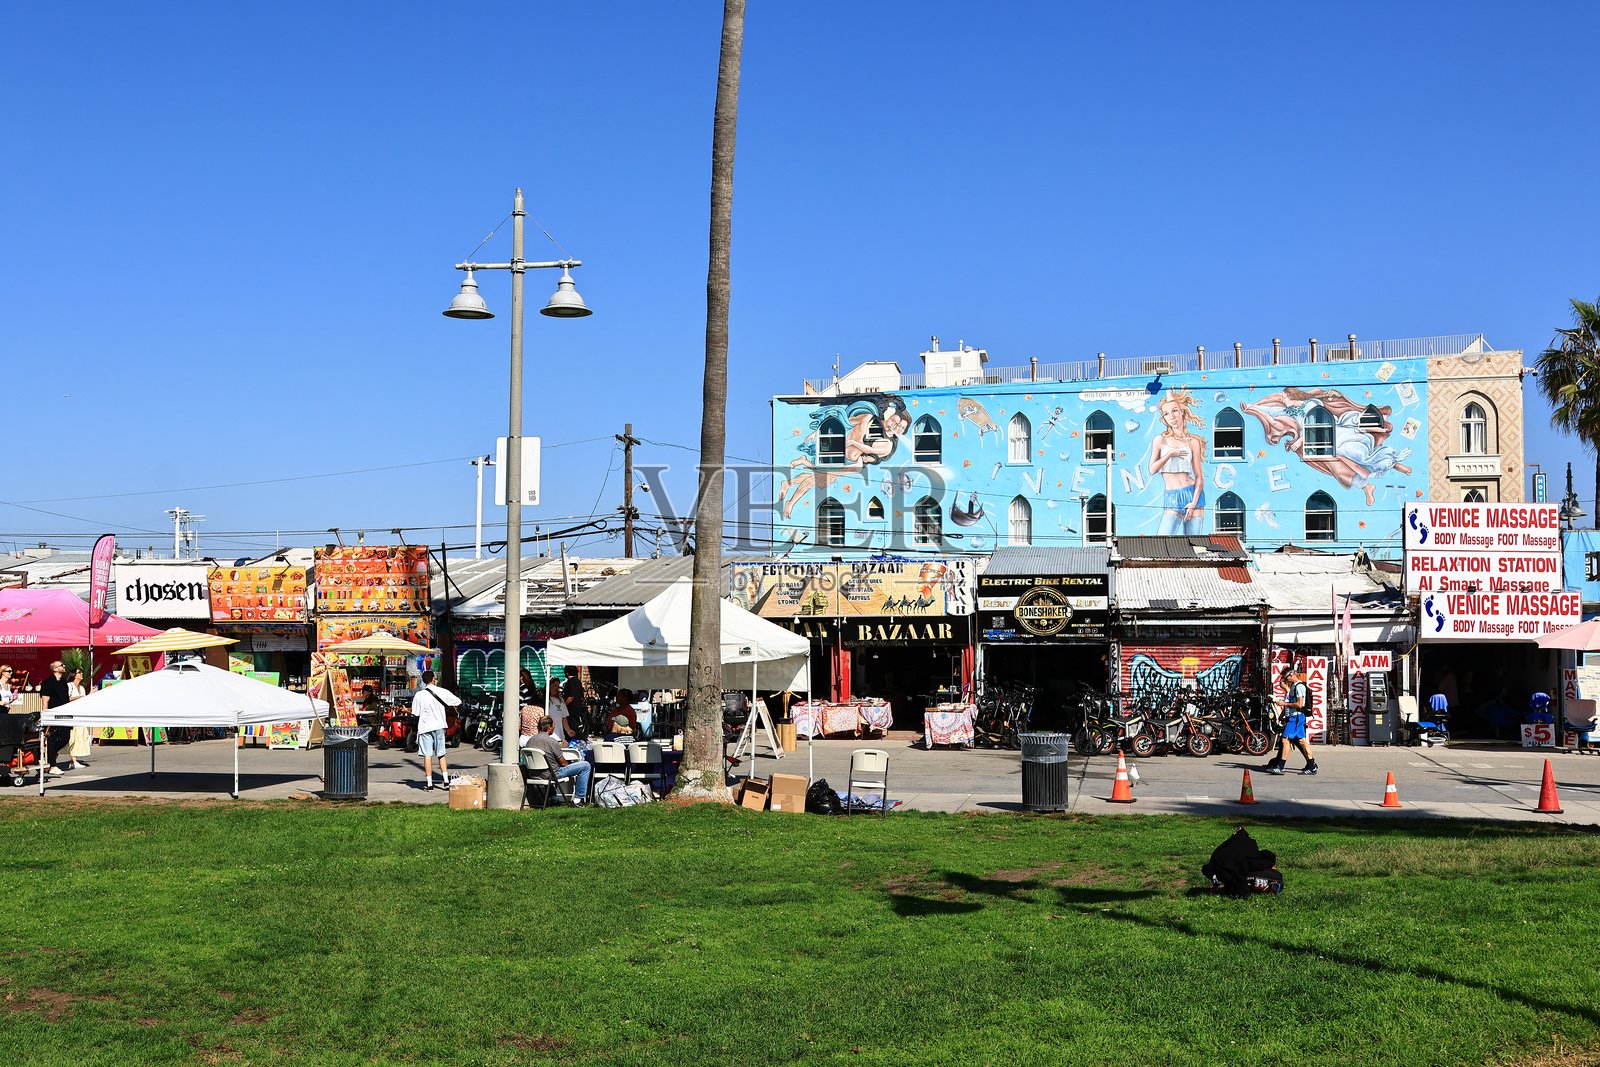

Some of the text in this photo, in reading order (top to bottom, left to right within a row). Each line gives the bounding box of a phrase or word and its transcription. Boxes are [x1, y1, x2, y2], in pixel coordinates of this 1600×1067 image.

[1084, 391, 1112, 399] HISTORY
[1429, 508, 1557, 529] VENICE MASSAGE
[1434, 532, 1557, 549] BODY Massage FOOT Massage
[762, 562, 904, 576] EGYPTIAN BAZAAR
[1498, 557, 1557, 573] STATION
[981, 577, 1103, 586] ELECTRIC BIKE RENTAL
[1419, 575, 1433, 590] AI
[1439, 575, 1483, 592] Smart
[125, 577, 205, 605] chosen
[983, 599, 1101, 607] RENT BUY
[1446, 594, 1579, 616] VENICE MASSAGE
[1018, 607, 1068, 617] BONESHAKER
[858, 623, 953, 641] BAZAAR
[1453, 620, 1476, 633] BODY
[1479, 620, 1515, 636] Massage
[1518, 620, 1540, 634] FOOT
[14, 634, 25, 644] THE
[26, 634, 38, 644] DAY
[1361, 655, 1389, 668] ATM
[1308, 658, 1326, 744] MASSAGE
[1524, 724, 1551, 742] $5
